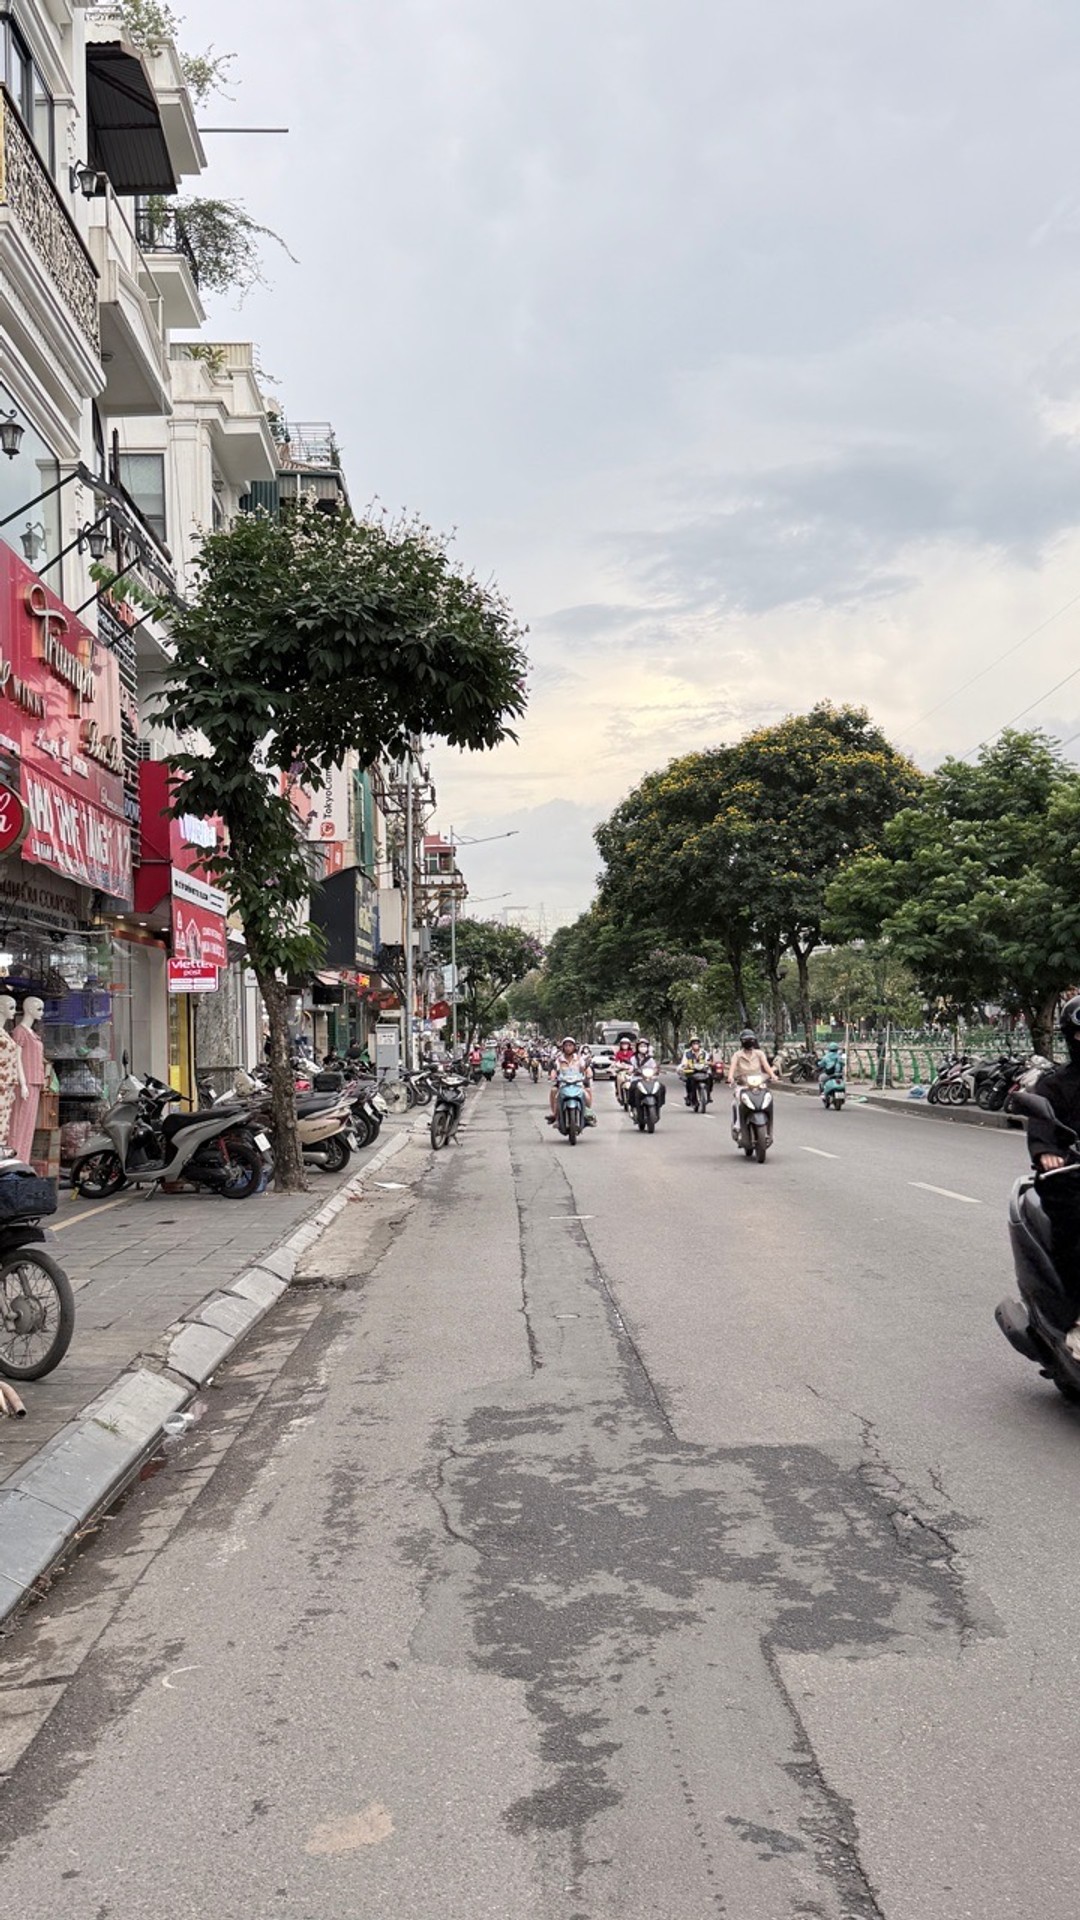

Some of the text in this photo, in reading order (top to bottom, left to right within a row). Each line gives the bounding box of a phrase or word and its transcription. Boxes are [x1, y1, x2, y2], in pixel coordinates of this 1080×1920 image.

[26, 584, 94, 716] Triumph
[14, 675, 47, 720] WINNY
[183, 969, 202, 977] post
